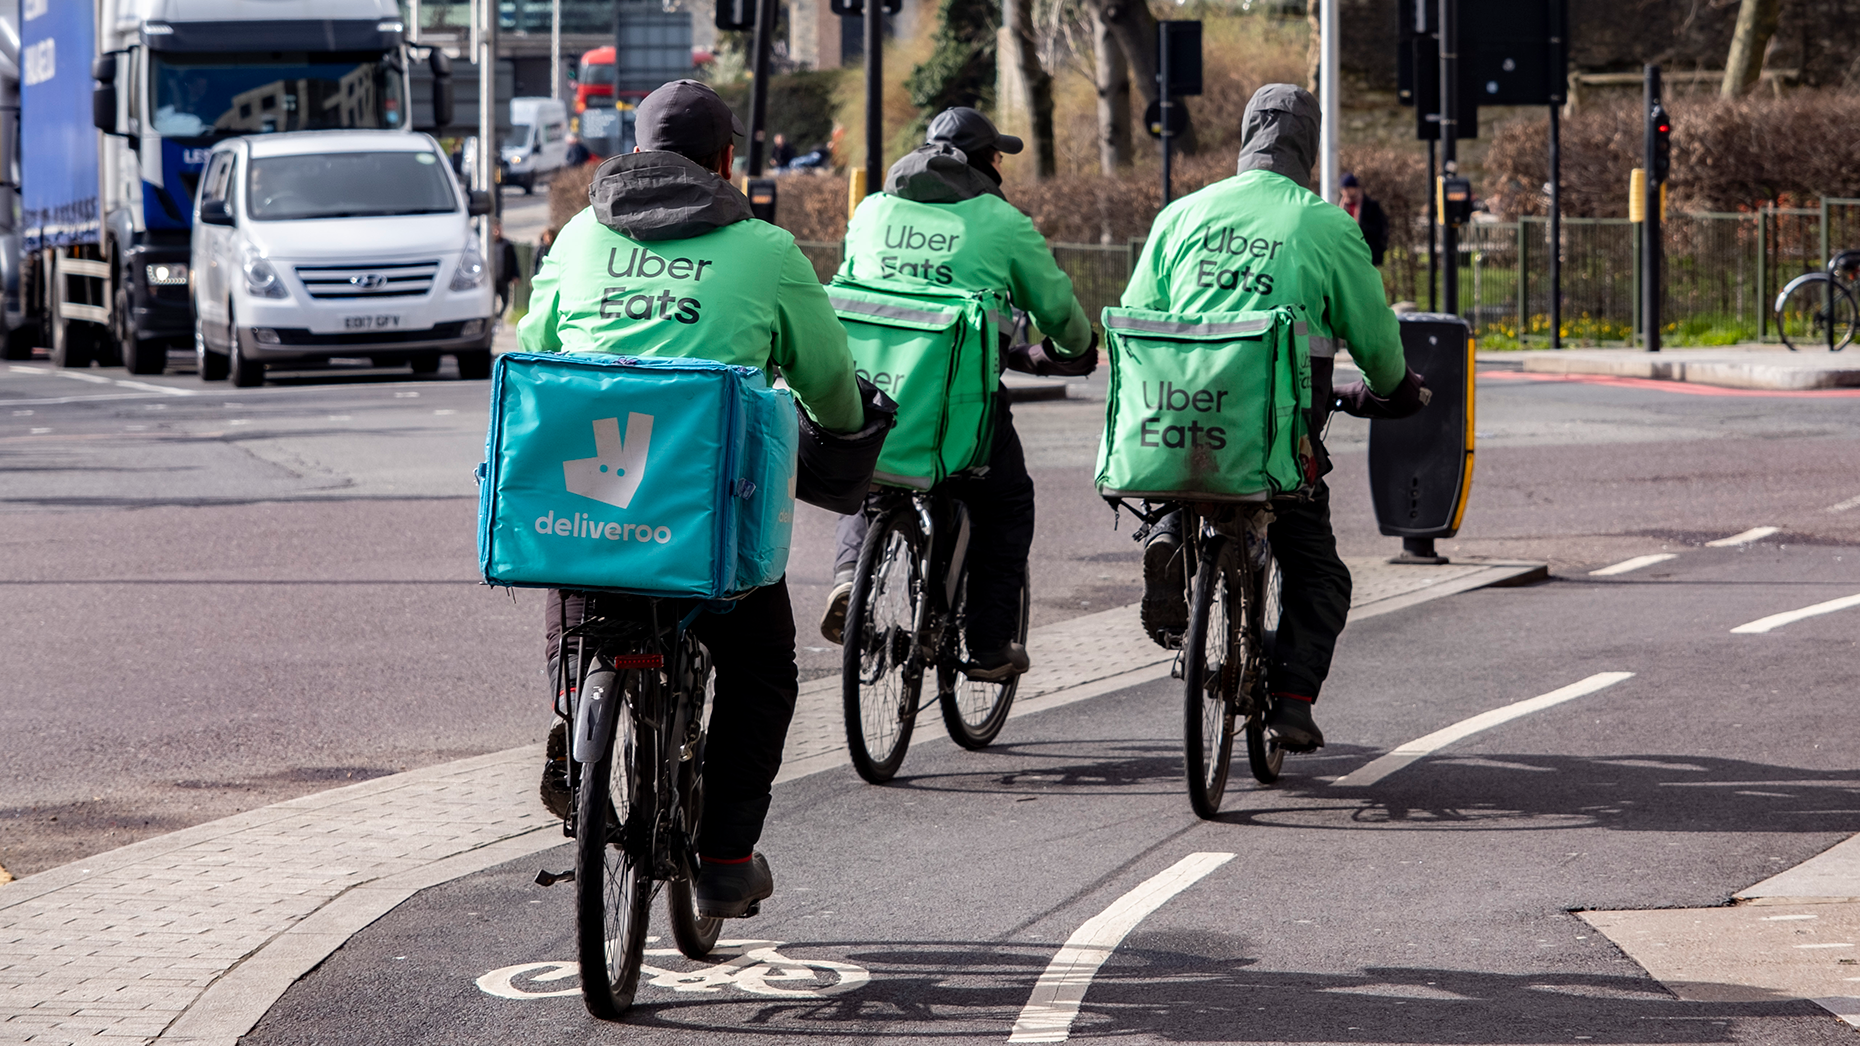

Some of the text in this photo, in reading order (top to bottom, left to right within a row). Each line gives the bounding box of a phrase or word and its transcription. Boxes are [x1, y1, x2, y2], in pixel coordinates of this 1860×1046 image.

[885, 225, 960, 252] Uber
[1203, 226, 1283, 260] Uber
[607, 247, 713, 281] Uber
[881, 256, 954, 285] Eats
[1197, 260, 1274, 295] Eats
[599, 287, 702, 324] Eats
[1142, 381, 1228, 413] Uber
[1141, 417, 1227, 450] Eats
[534, 510, 672, 544] deliveroo
